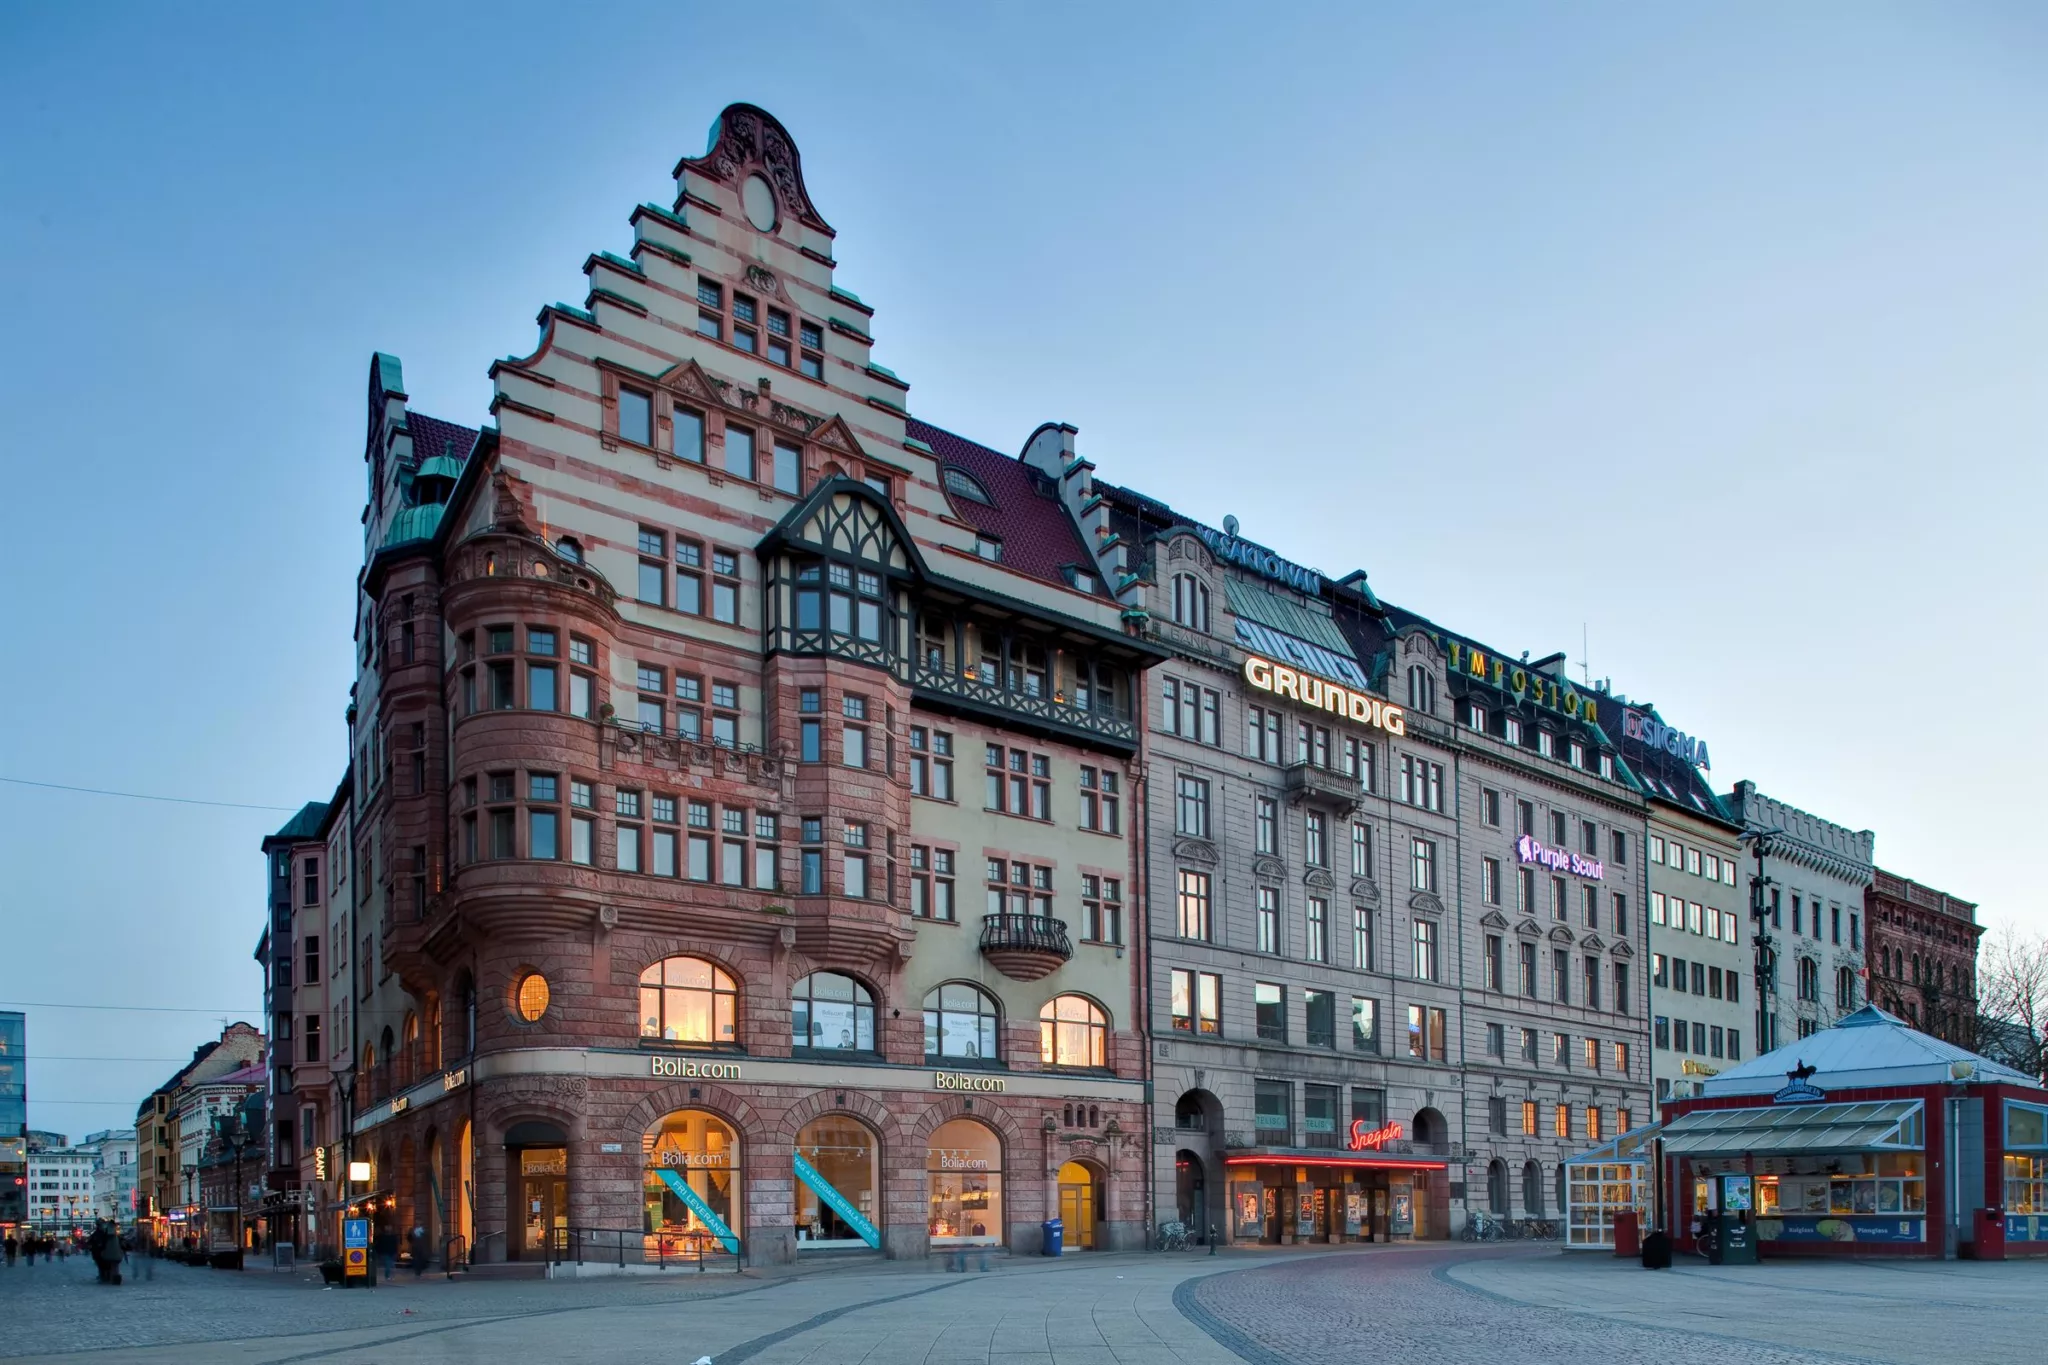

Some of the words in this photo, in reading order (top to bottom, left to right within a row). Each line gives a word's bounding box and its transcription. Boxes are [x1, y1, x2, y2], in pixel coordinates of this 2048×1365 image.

[1171, 627, 1212, 654] BANK
[1432, 631, 1598, 723] YMPOSION
[1244, 656, 1405, 737] GRUNDIG
[1642, 715, 1711, 771] SIGMA
[1532, 841, 1570, 871] Purple
[1571, 853, 1604, 880] Scout
[651, 1055, 742, 1079] Bolia.com
[935, 1071, 1006, 1092] Bolia.com
[1348, 1118, 1404, 1151] Spegeln
[315, 1146, 326, 1181] GRANIT
[661, 1151, 722, 1165] Bolia.com
[941, 1155, 988, 1169] Bolia.com
[672, 1180, 688, 1196] FRI
[686, 1194, 726, 1236] LEVERANS
[836, 1199, 859, 1222] BETALA
